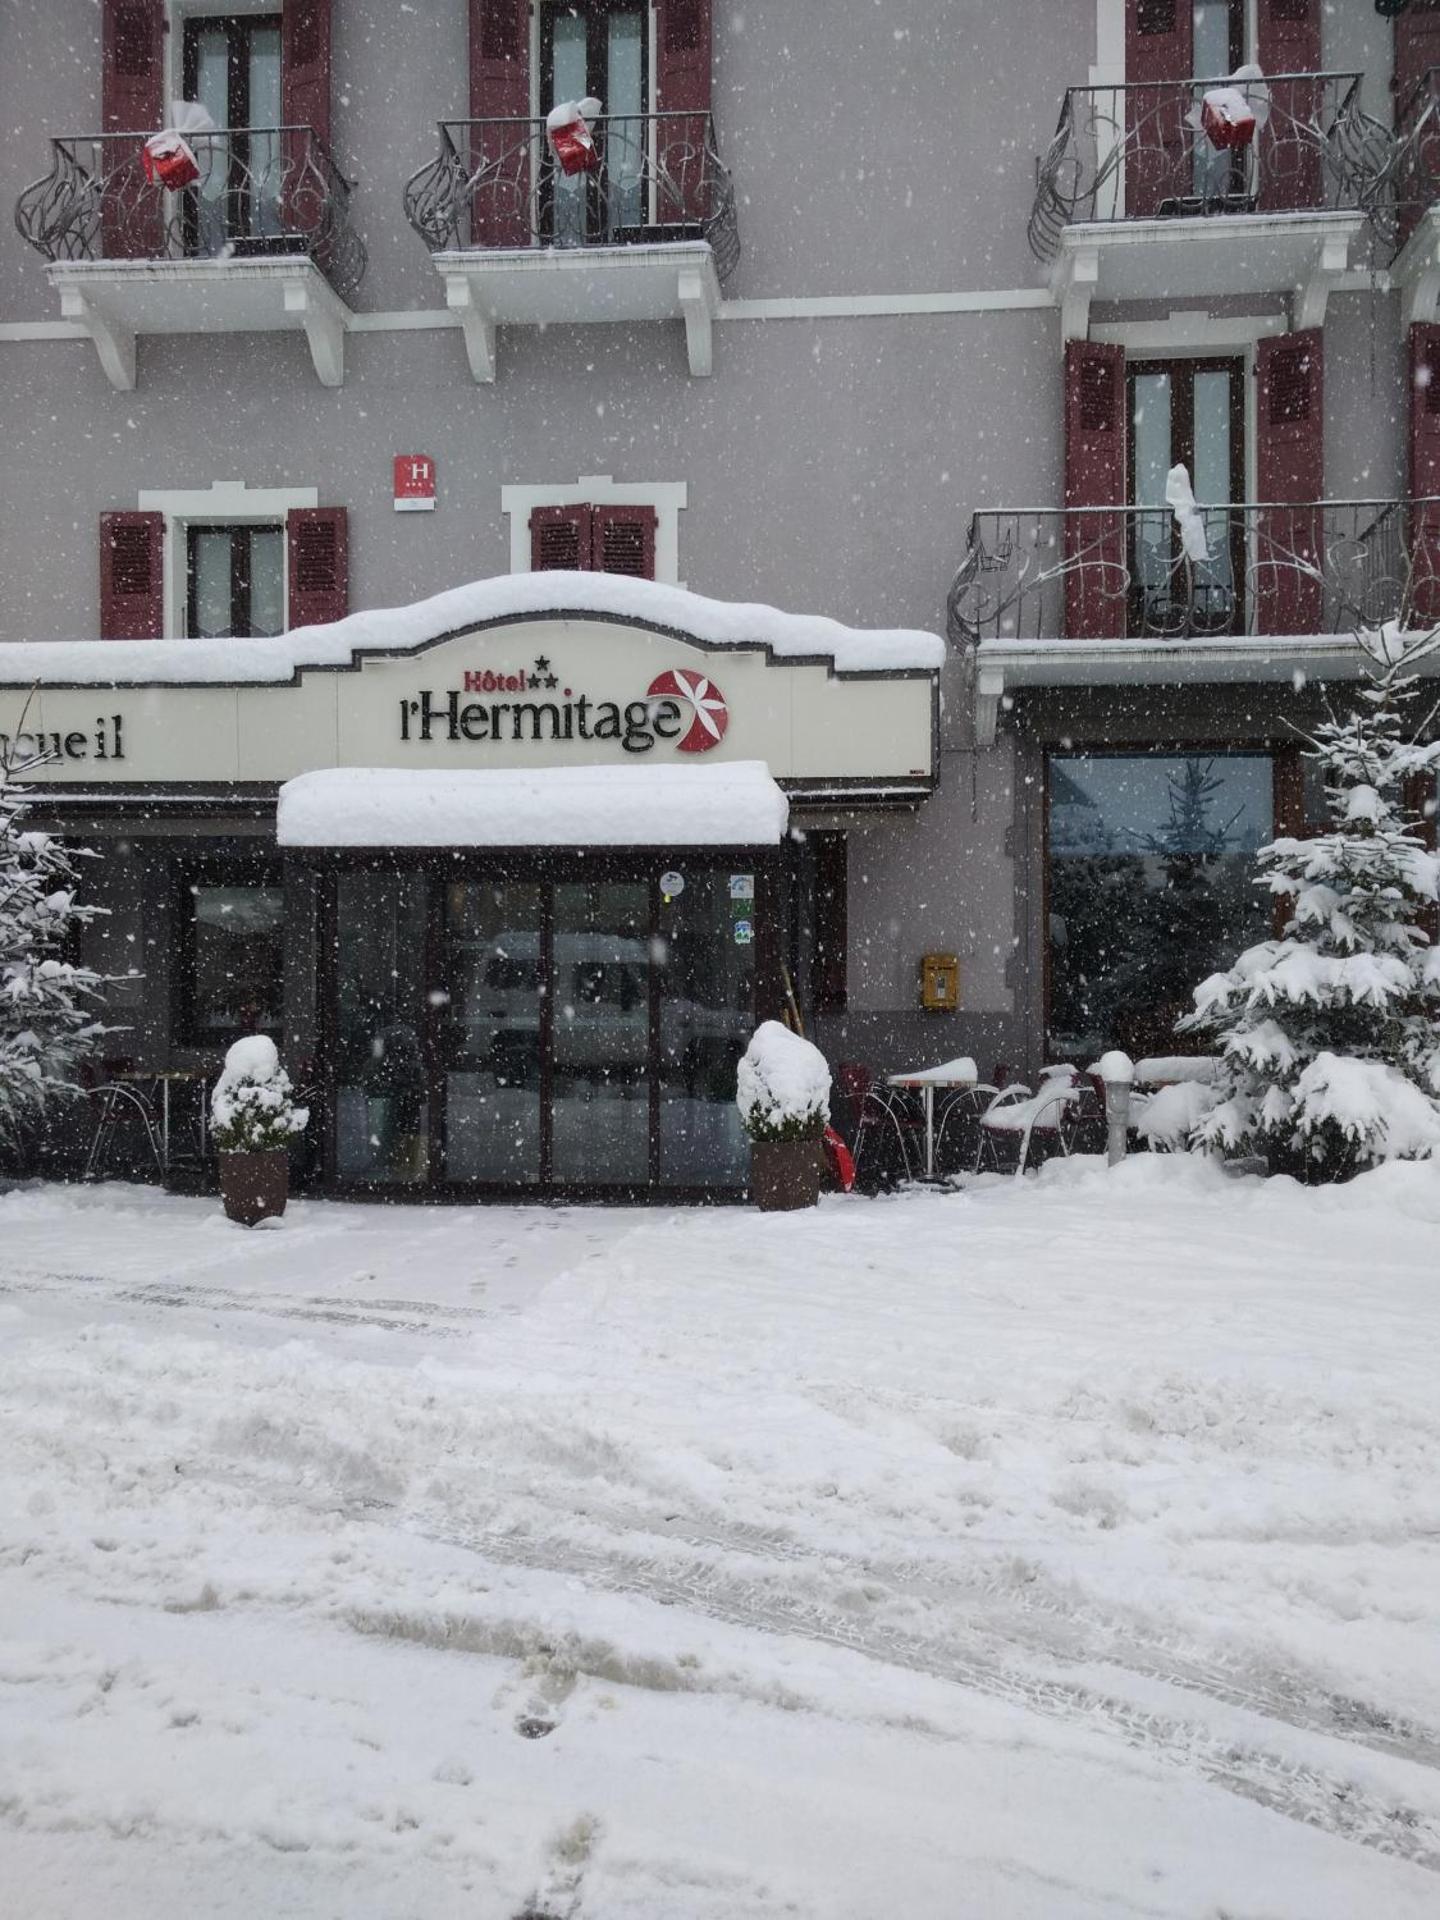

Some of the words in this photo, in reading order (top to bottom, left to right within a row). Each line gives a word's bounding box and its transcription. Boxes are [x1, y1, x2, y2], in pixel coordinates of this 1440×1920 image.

[412, 463, 429, 480] H
[464, 670, 526, 693] Hôtel
[400, 688, 682, 753] l'Hermitage
